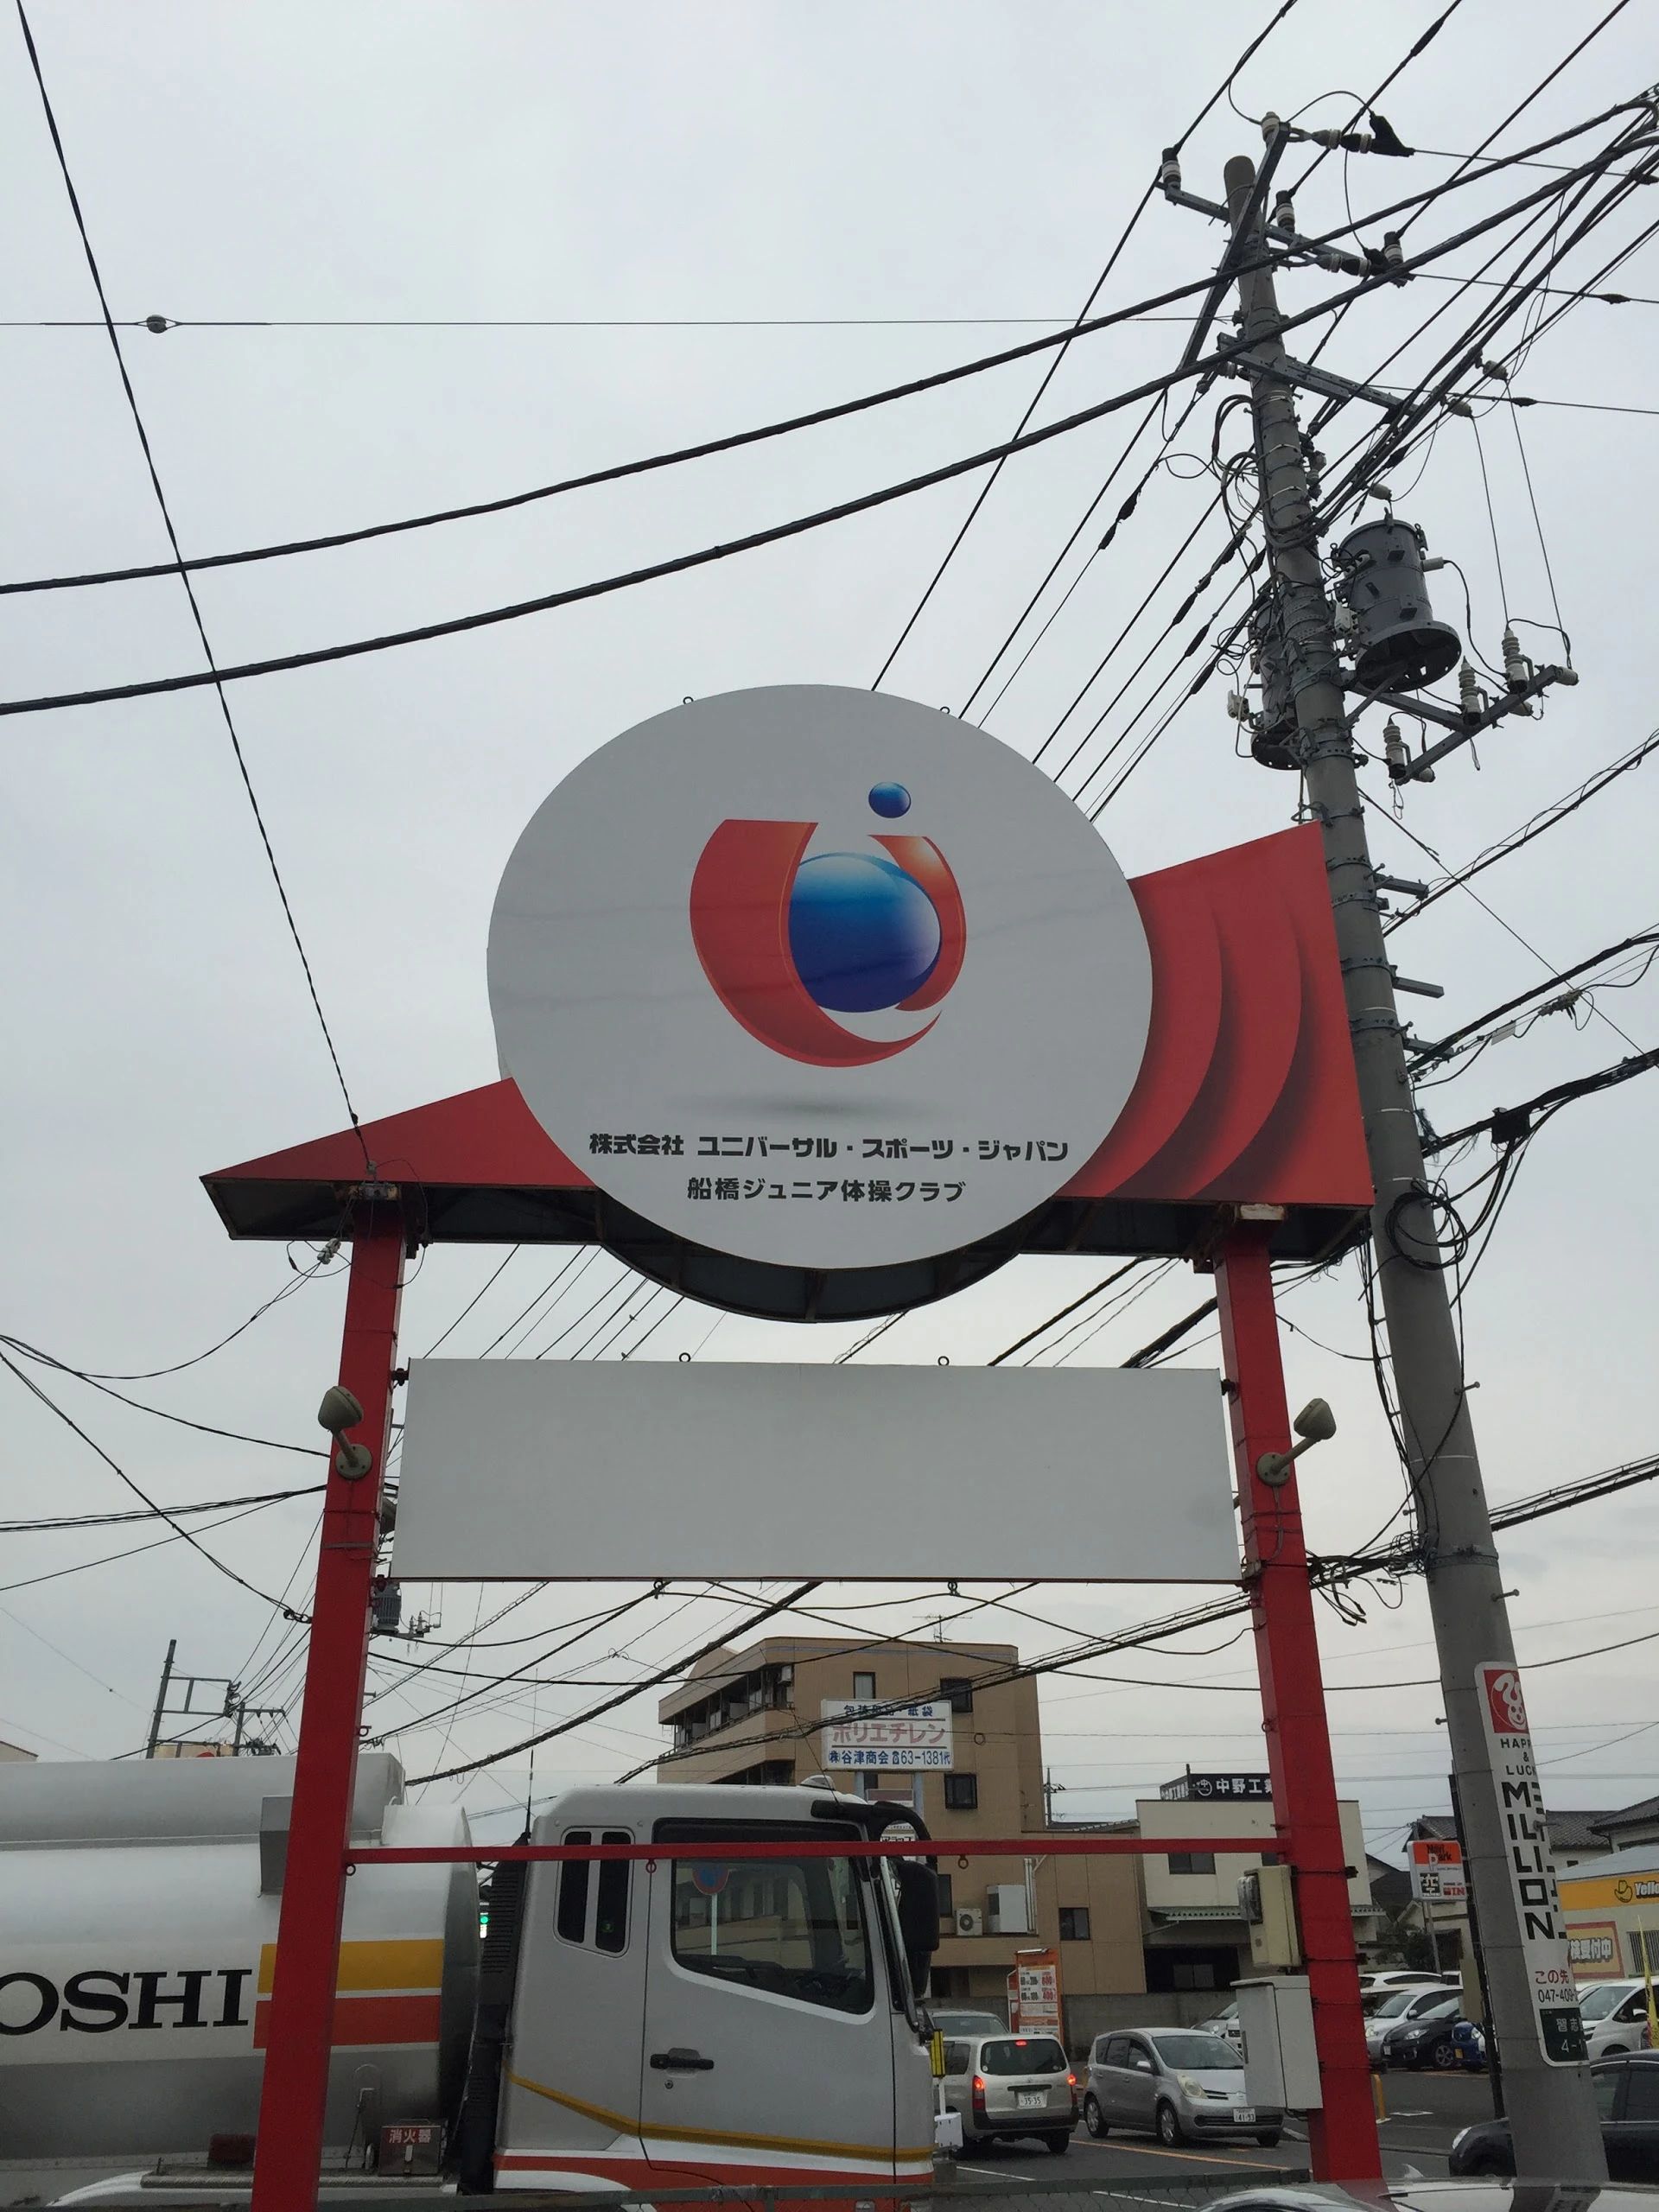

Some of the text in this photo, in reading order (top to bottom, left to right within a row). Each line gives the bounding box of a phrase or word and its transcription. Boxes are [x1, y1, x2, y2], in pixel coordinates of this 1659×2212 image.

[589, 1133, 1069, 1162] 株式会社 ユニバーサル・スポーツ・ジャパン
[687, 1177, 967, 1203] 船橋ジュニア体操クラブ
[832, 1722, 946, 1744] ポリエチレン
[1522, 1751, 1529, 1763] &
[1535, 1969, 1569, 1985] この先
[389, 2128, 432, 2144] 消火器
